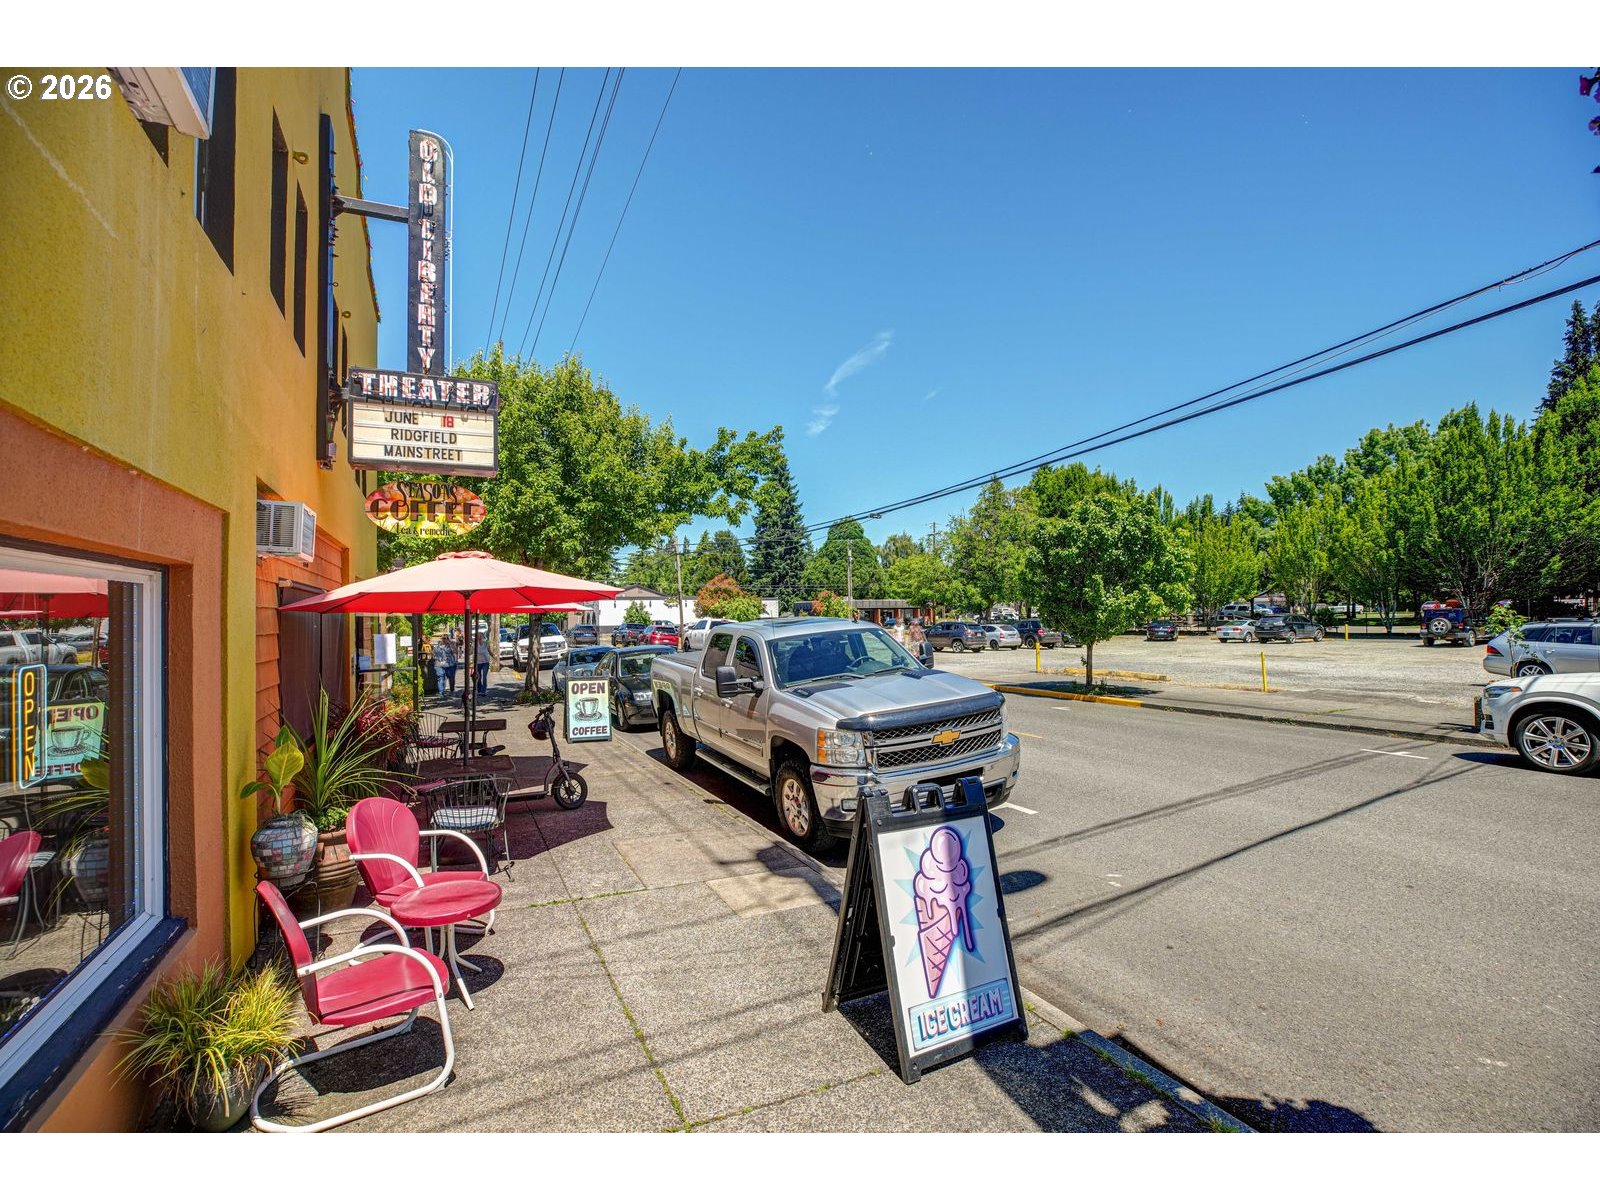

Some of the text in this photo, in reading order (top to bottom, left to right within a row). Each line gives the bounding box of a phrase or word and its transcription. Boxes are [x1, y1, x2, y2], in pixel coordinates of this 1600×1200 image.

[417, 139, 438, 371] OLD LIBERTY
[360, 372, 490, 406] THEATER
[384, 411, 454, 428] JUNE 18
[390, 428, 458, 445] RIDGFIELD
[384, 445, 463, 462] MAINSTREET
[396, 480, 458, 507] SEASONS
[370, 498, 480, 523] COFFEE
[420, 524, 458, 536] remedies
[571, 682, 606, 694] OPEN
[24, 671, 35, 780] OPEN
[572, 725, 608, 736] COFFEE
[917, 987, 1004, 1041] ICE CREAM
